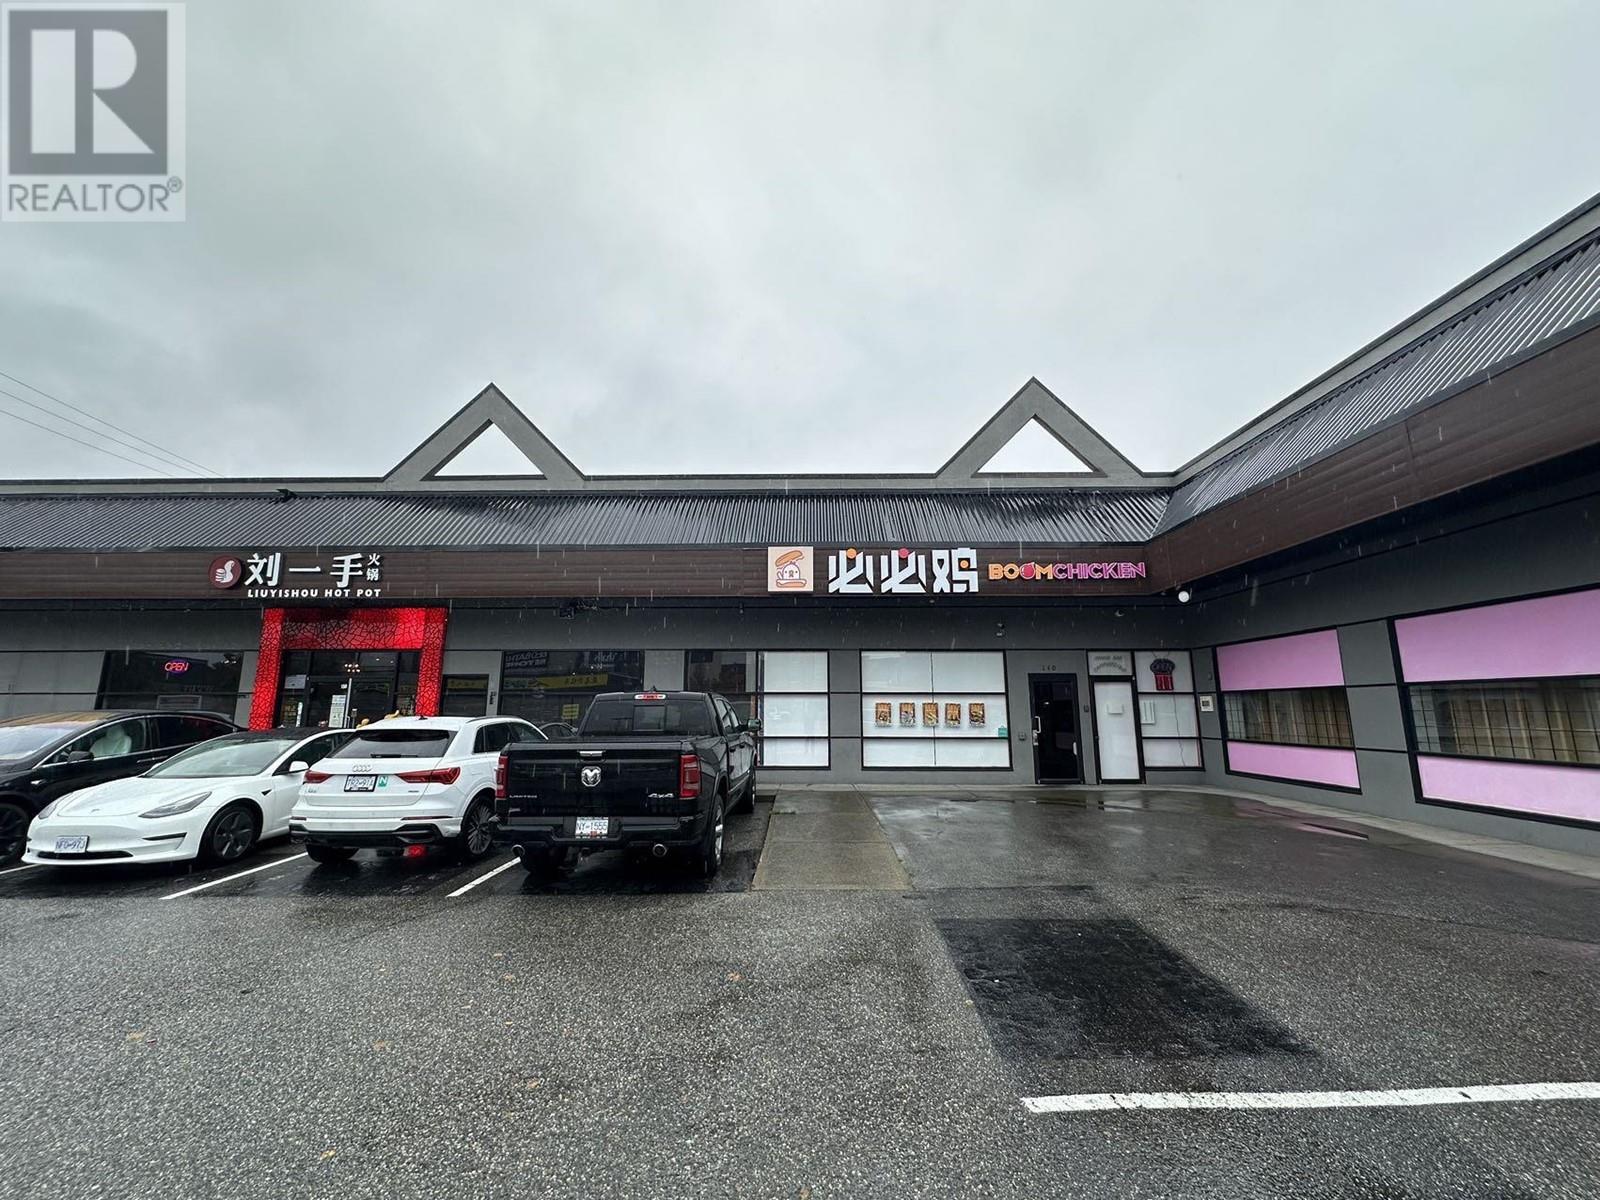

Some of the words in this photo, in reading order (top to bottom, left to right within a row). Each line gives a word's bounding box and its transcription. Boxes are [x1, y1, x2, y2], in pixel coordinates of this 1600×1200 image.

[244, 552, 363, 588] 刘一手
[366, 553, 381, 581] 火锅
[247, 589, 318, 598] LIUYISHOU
[324, 589, 351, 598] HOT
[356, 589, 382, 598] POT
